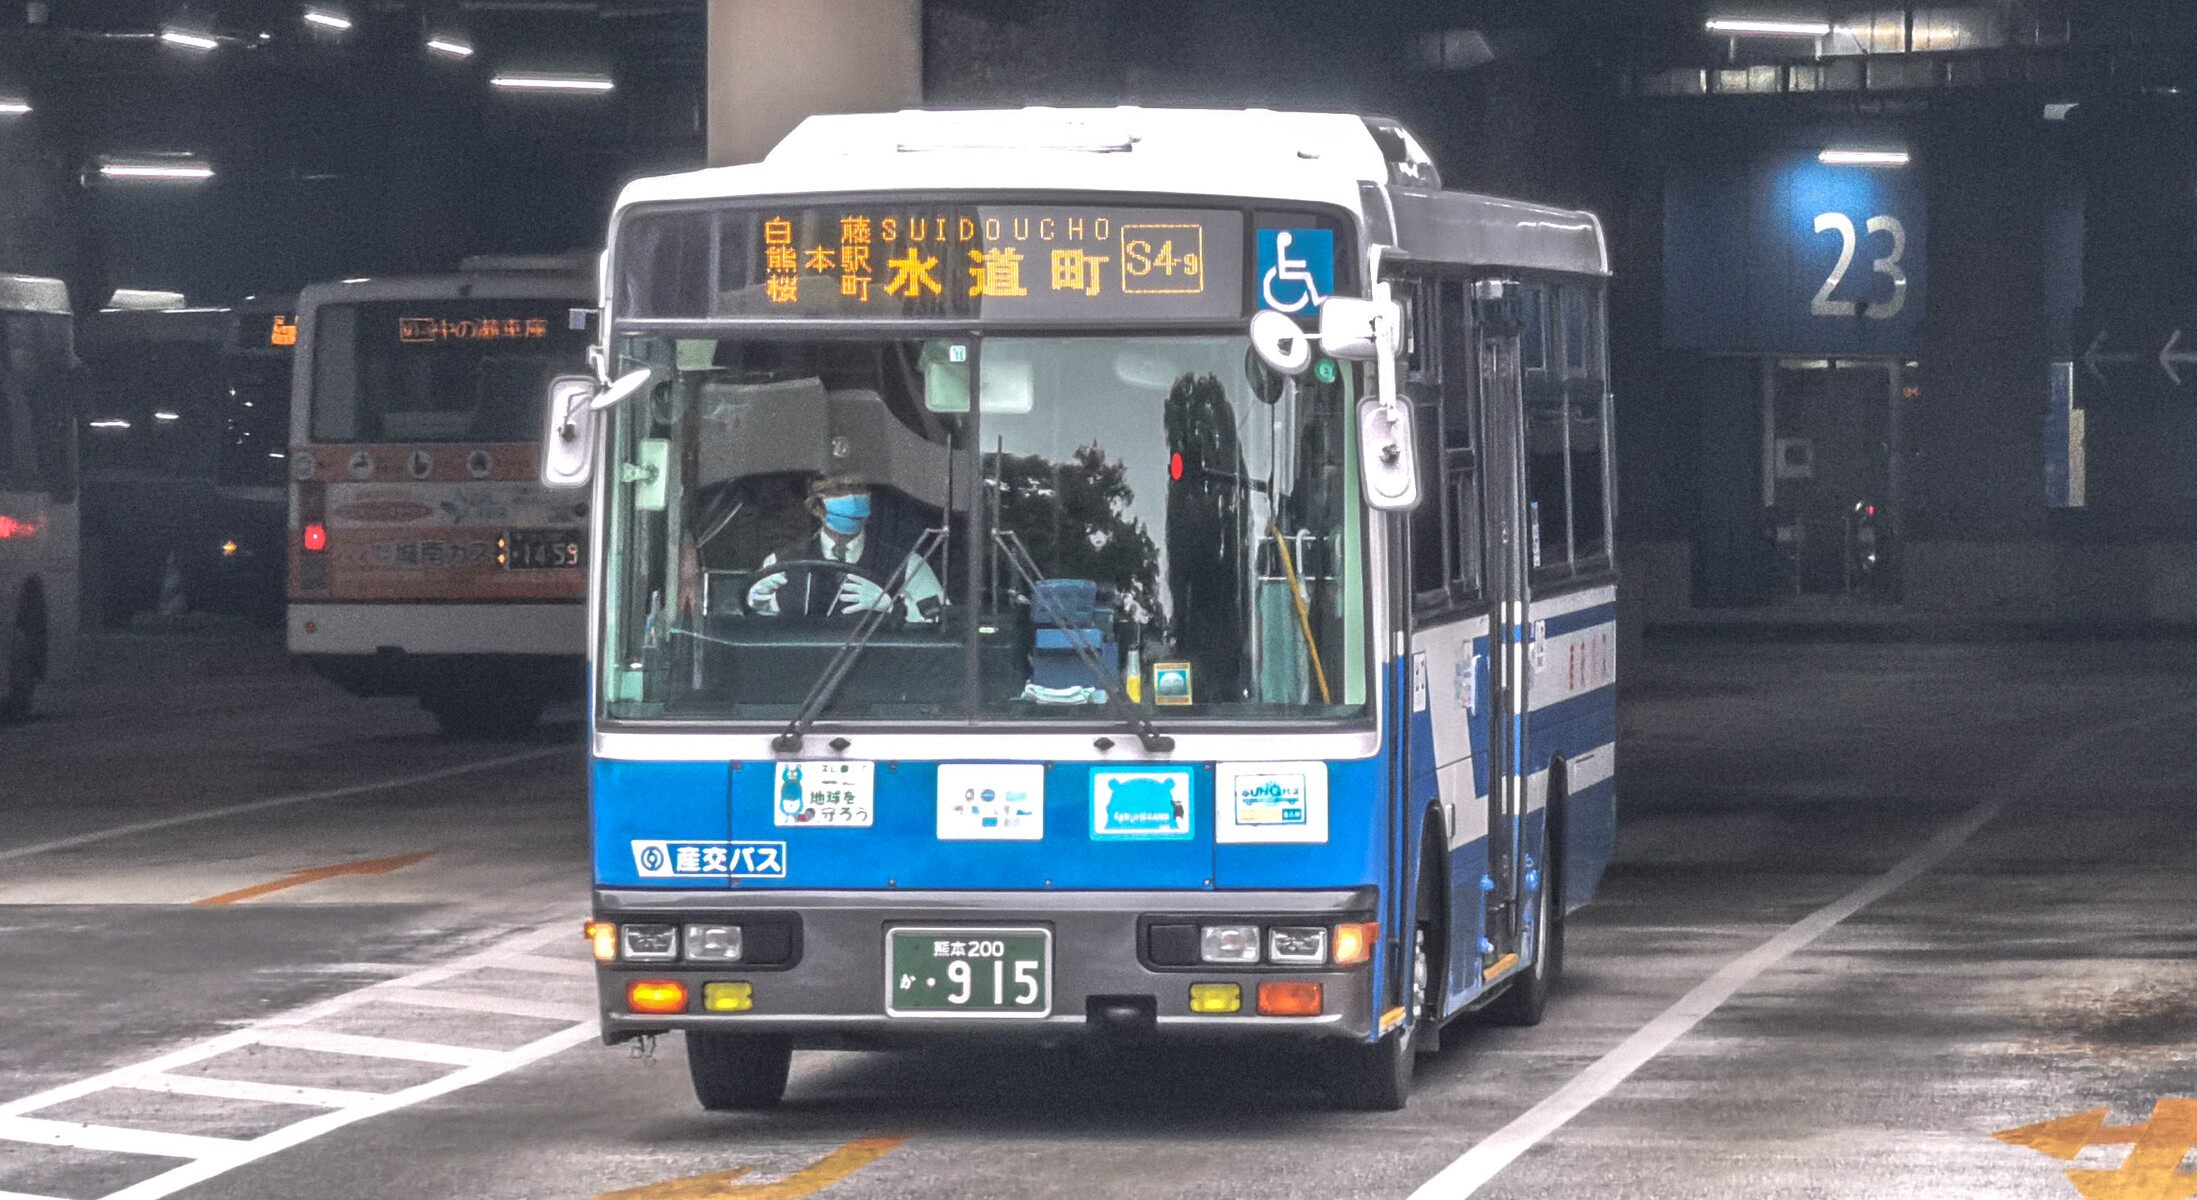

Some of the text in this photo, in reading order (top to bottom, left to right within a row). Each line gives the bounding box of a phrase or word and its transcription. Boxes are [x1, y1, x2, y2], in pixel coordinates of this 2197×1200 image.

[881, 217, 1110, 242] SUIDOUCHO
[883, 246, 1110, 297] 水道町
[1811, 212, 1907, 319] 23
[676, 846, 781, 873] 産交バス
[933, 941, 1005, 957] 熊本200
[900, 973, 916, 990] か
